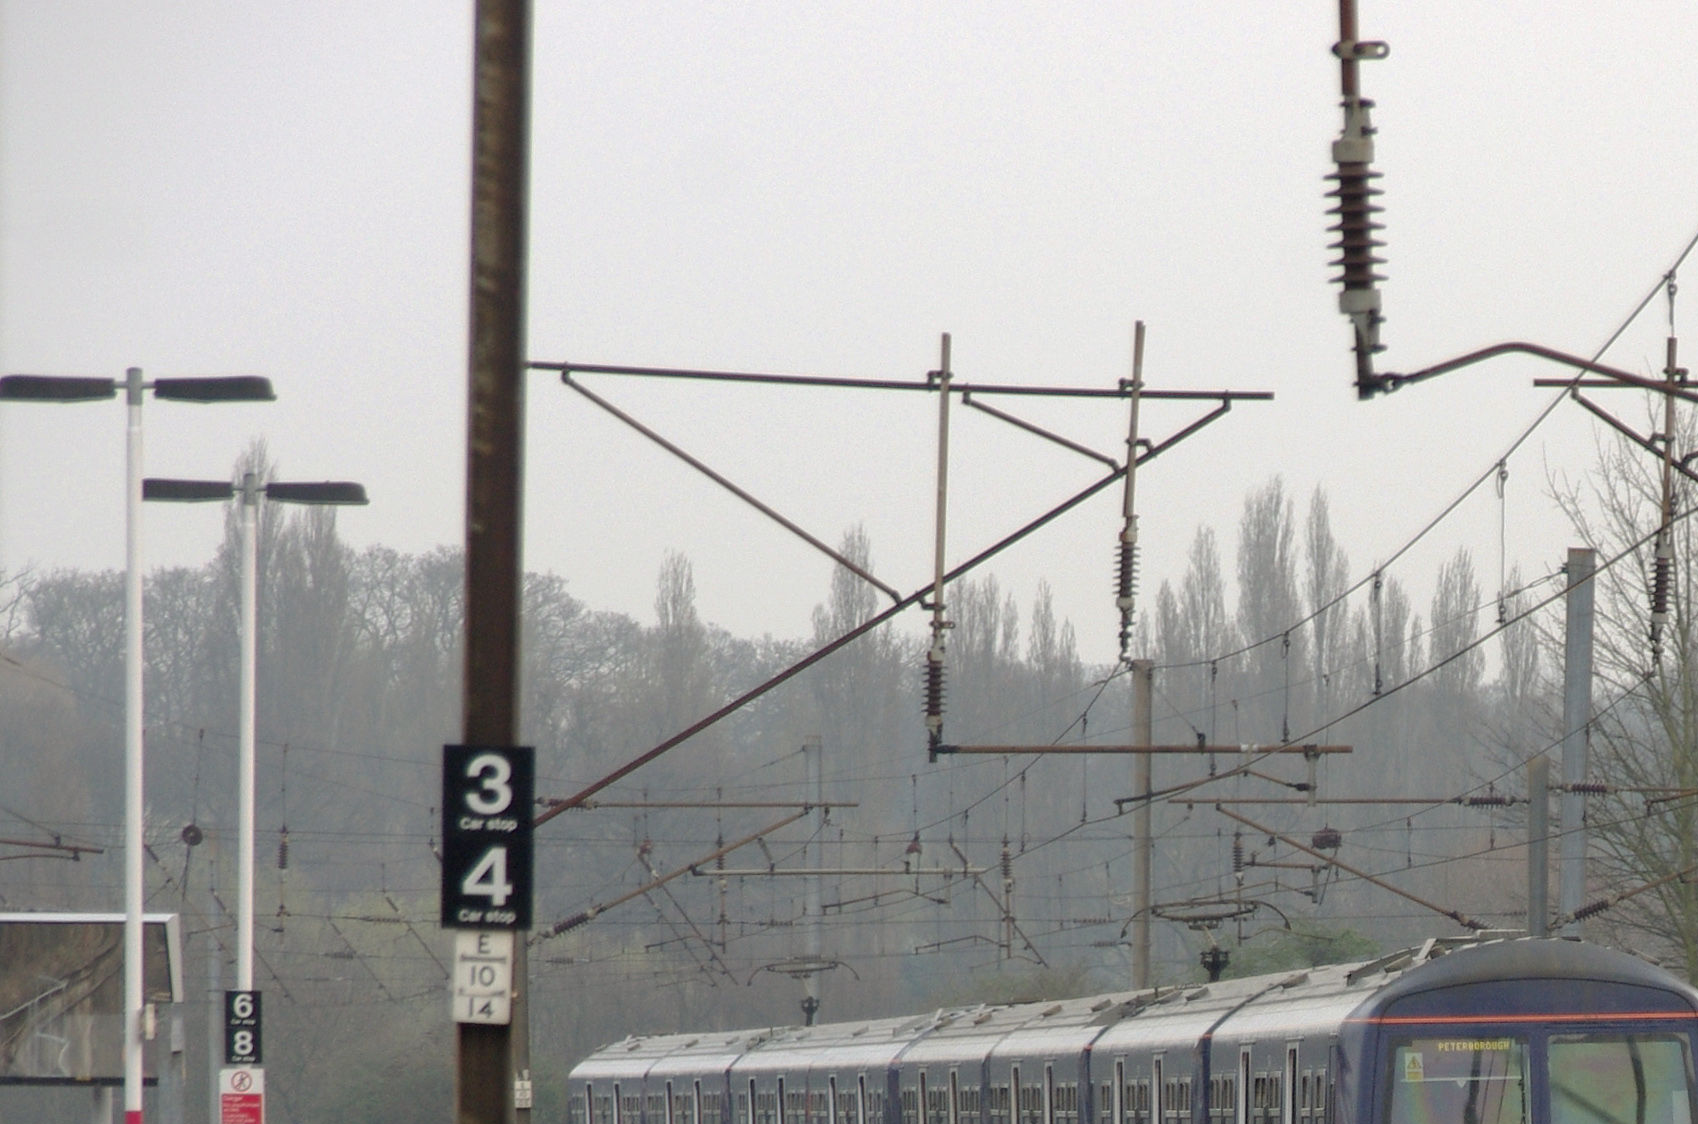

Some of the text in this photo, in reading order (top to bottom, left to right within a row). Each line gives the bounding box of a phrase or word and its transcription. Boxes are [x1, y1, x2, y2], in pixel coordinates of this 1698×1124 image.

[466, 754, 513, 815] 3
[459, 817, 518, 832] Car stop
[462, 846, 513, 908] 4
[458, 909, 516, 924] Car stop
[477, 935, 491, 955] E
[470, 965, 495, 987] 10
[234, 994, 253, 1018] 6
[467, 998, 494, 1020] 14
[234, 1030, 253, 1055] 8
[1438, 1040, 1511, 1052] PETERBOROUGH
